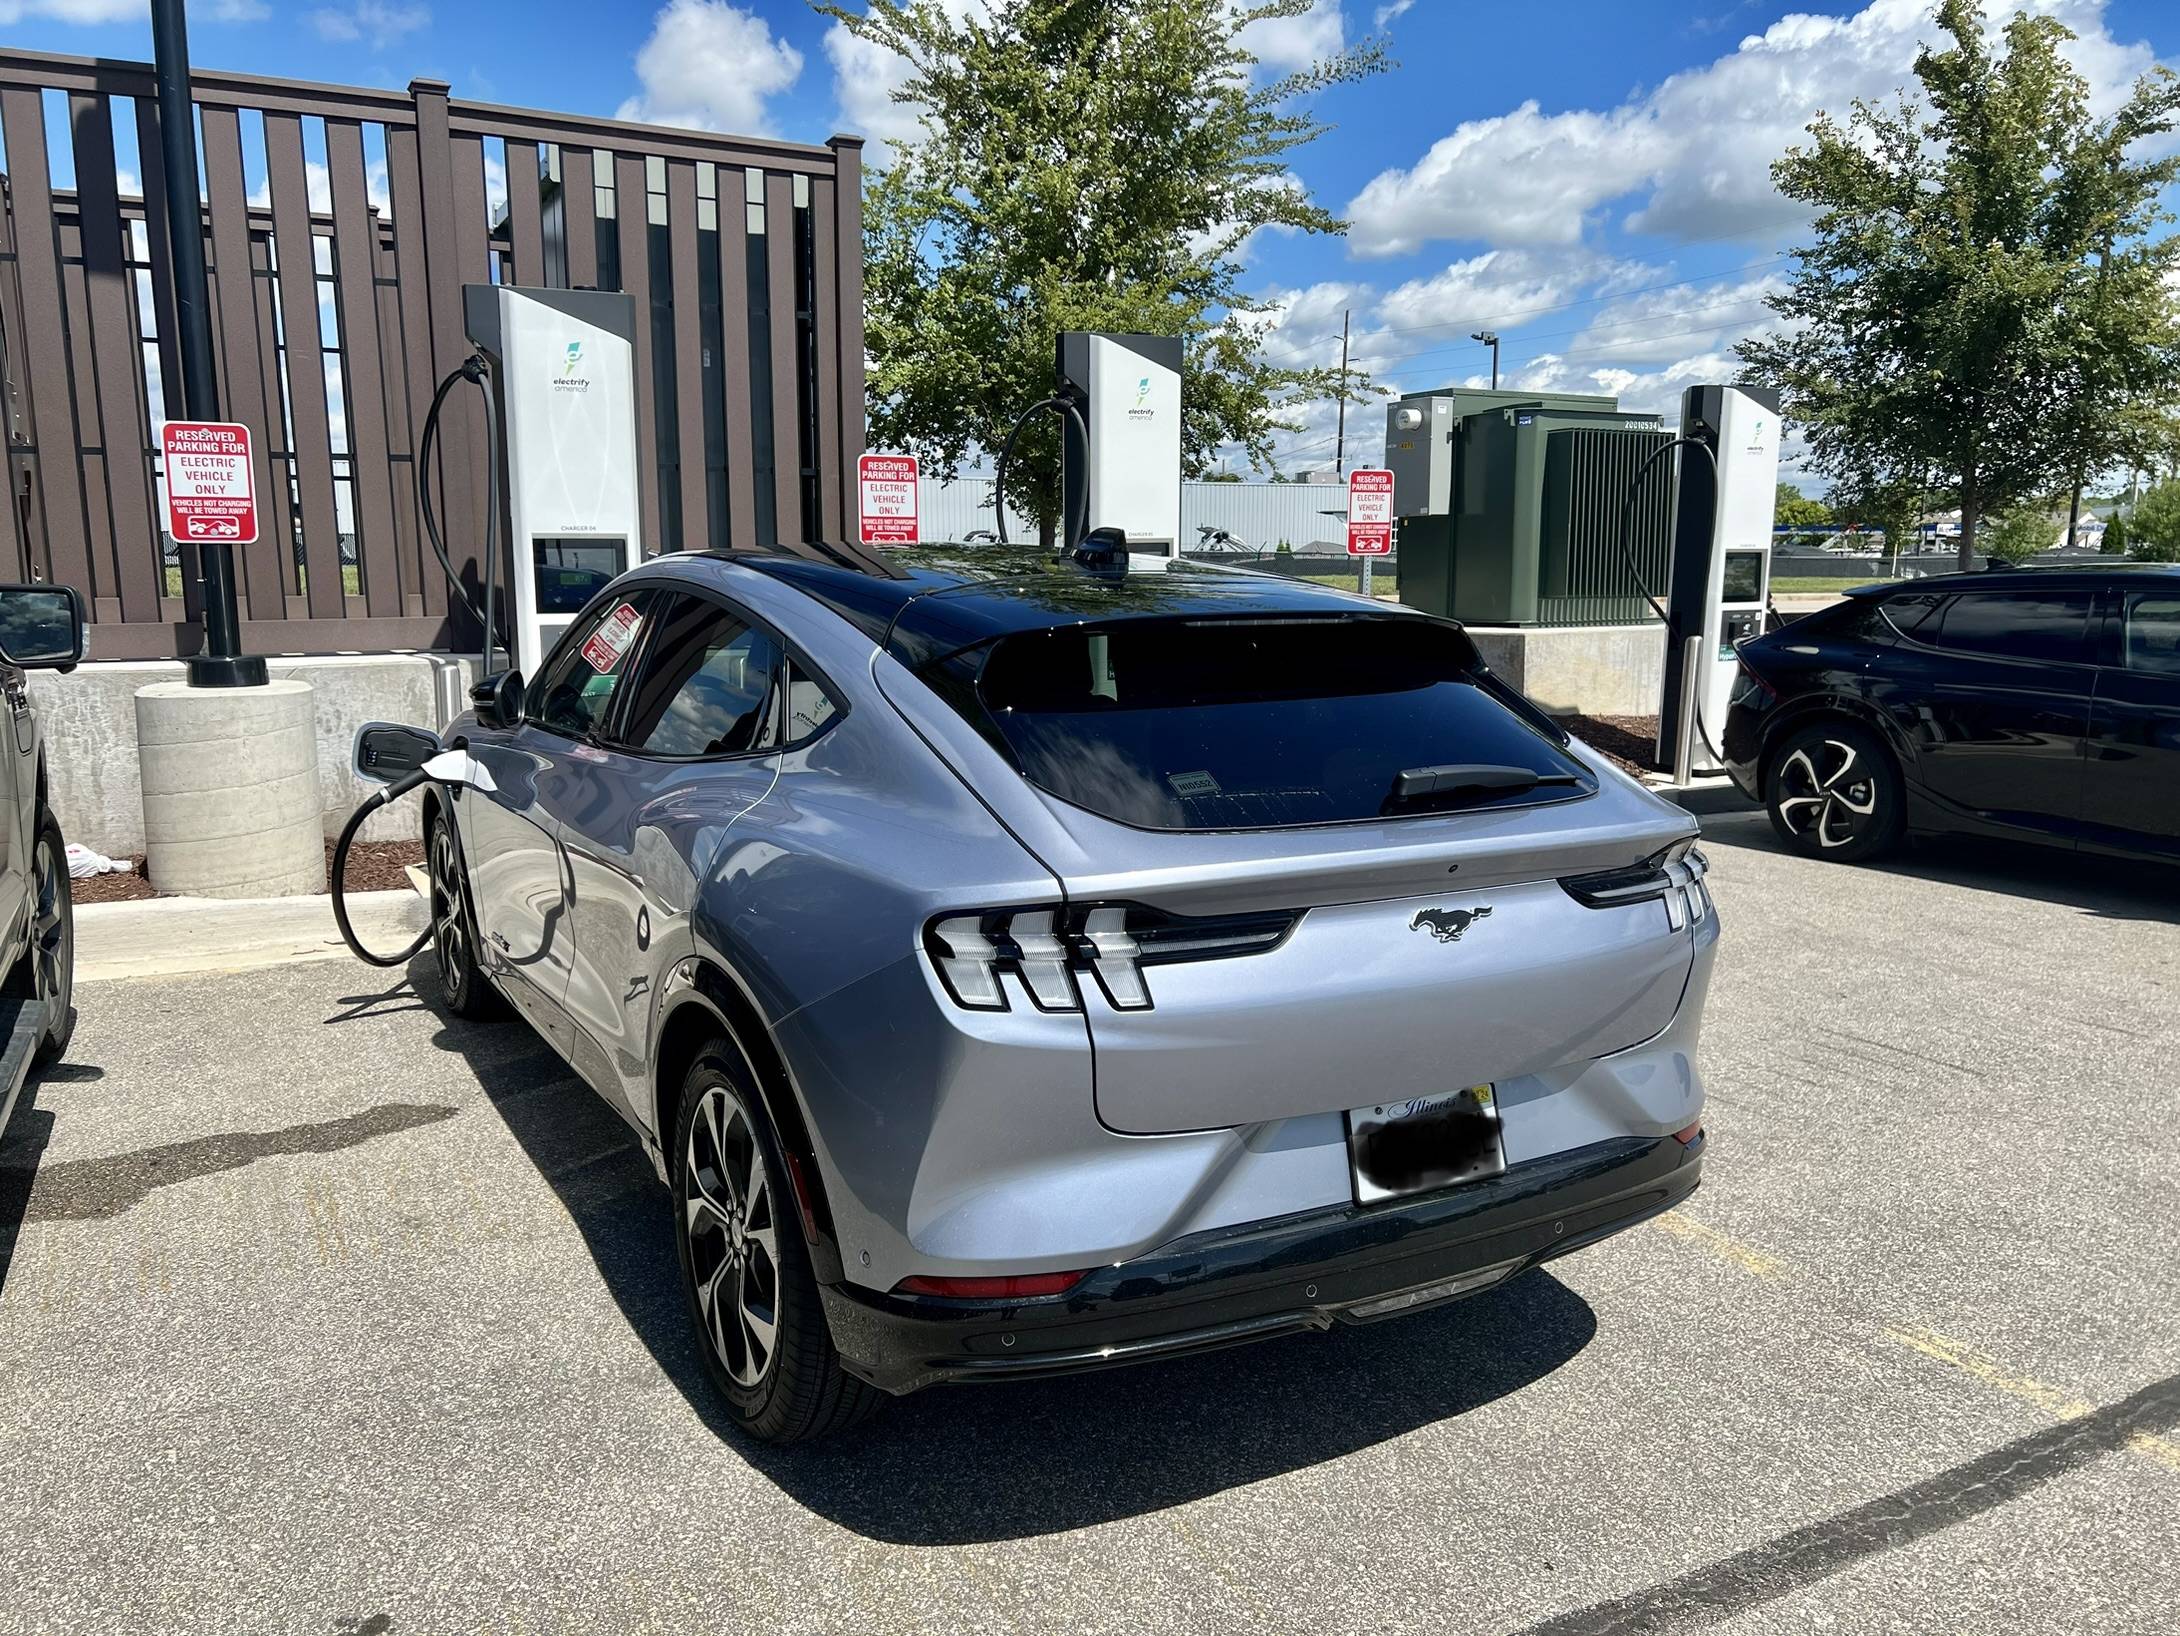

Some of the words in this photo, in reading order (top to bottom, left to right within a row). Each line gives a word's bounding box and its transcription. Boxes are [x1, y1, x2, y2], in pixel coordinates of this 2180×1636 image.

[553, 378, 590, 387] electrify
[175, 430, 236, 442] RESERVED
[167, 441, 219, 452] PARKING
[222, 442, 246, 453] FOR
[180, 457, 236, 468] ELECTRIC
[867, 461, 909, 471] RESERVED
[185, 471, 234, 481] VEHICLE
[862, 470, 897, 480] PARKING
[899, 472, 915, 480] FOR
[195, 484, 226, 495] ONLY
[870, 484, 908, 493] ELECTRIC
[1351, 483, 1378, 491] PARKING
[1379, 483, 1391, 491] FOR
[873, 495, 906, 504] VEHICLE
[1357, 494, 1385, 502] ELECTRIC
[218, 500, 252, 508] CHARGING
[879, 506, 900, 515] ONLY
[1362, 513, 1379, 521] ONLY
[1389, 1097, 1457, 1119] Illinois
